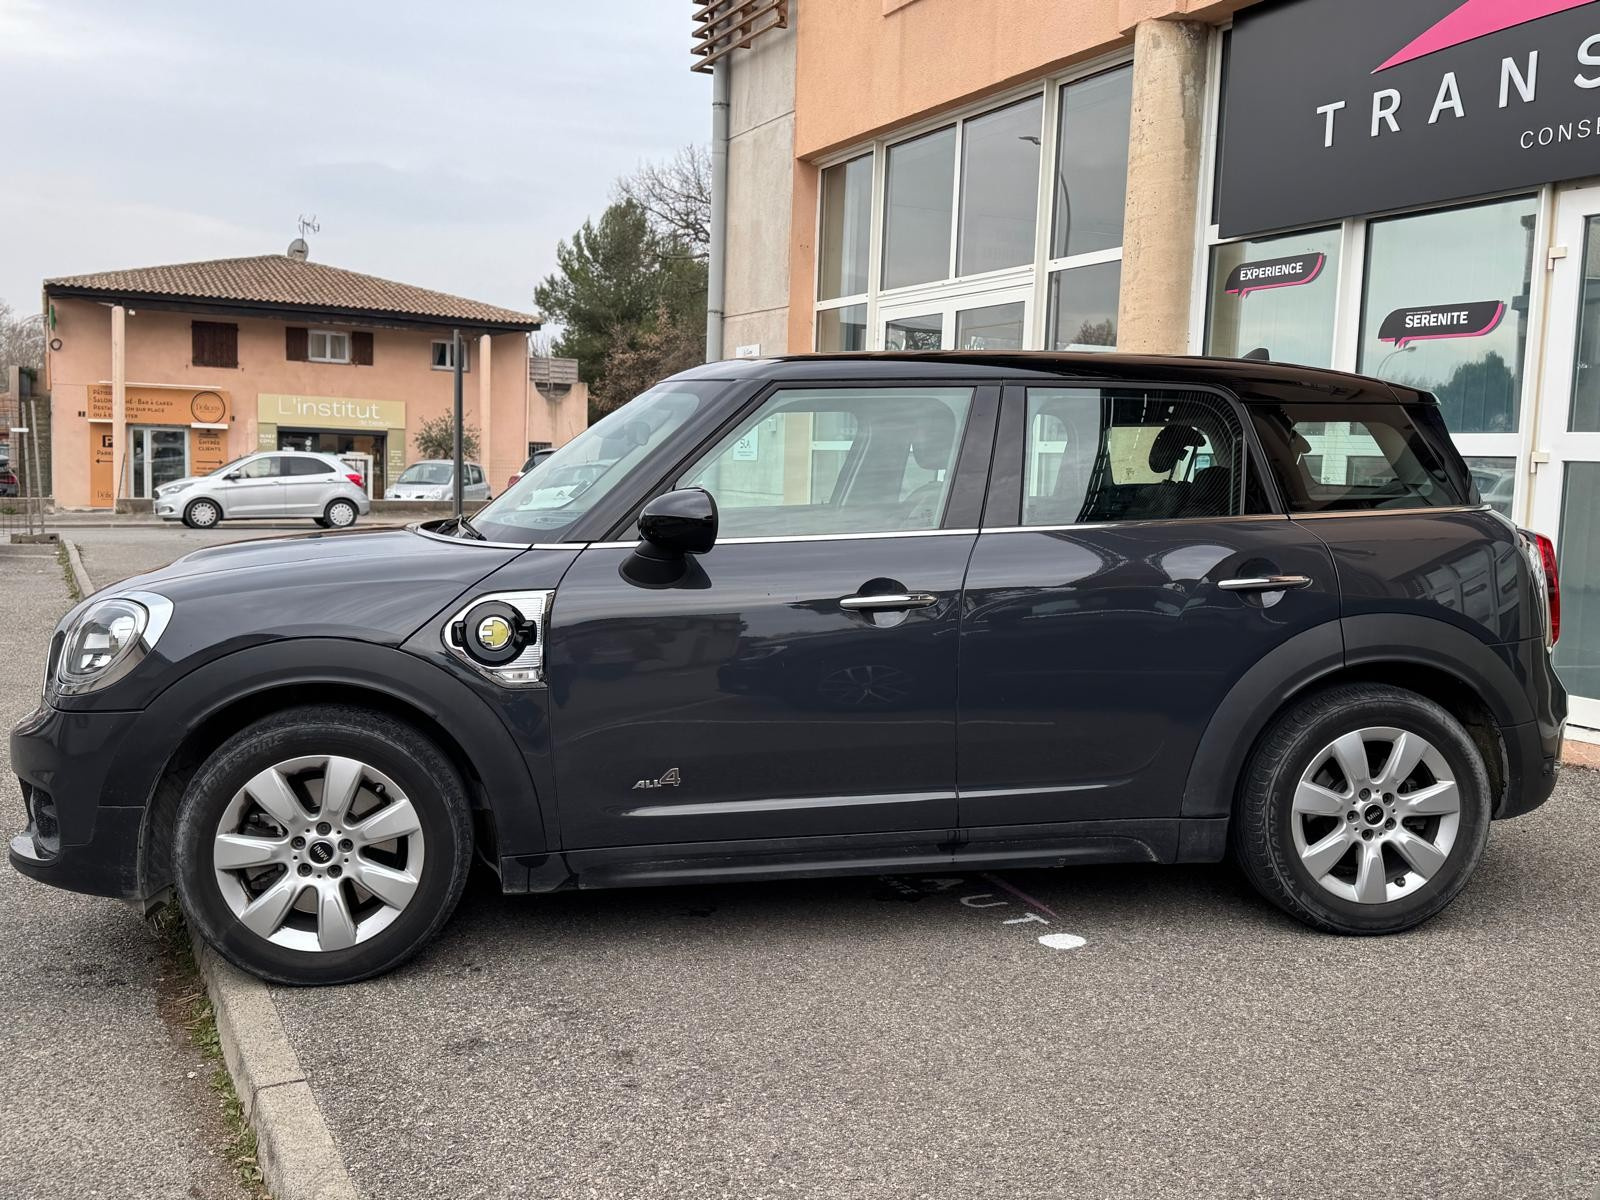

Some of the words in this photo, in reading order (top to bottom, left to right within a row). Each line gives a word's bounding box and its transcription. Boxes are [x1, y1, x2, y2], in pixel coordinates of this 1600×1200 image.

[1316, 33, 1600, 147] TRANS
[1240, 262, 1303, 280] EXPERIENCE
[1405, 311, 1468, 328] SERENITE
[278, 395, 380, 419] L'institut
